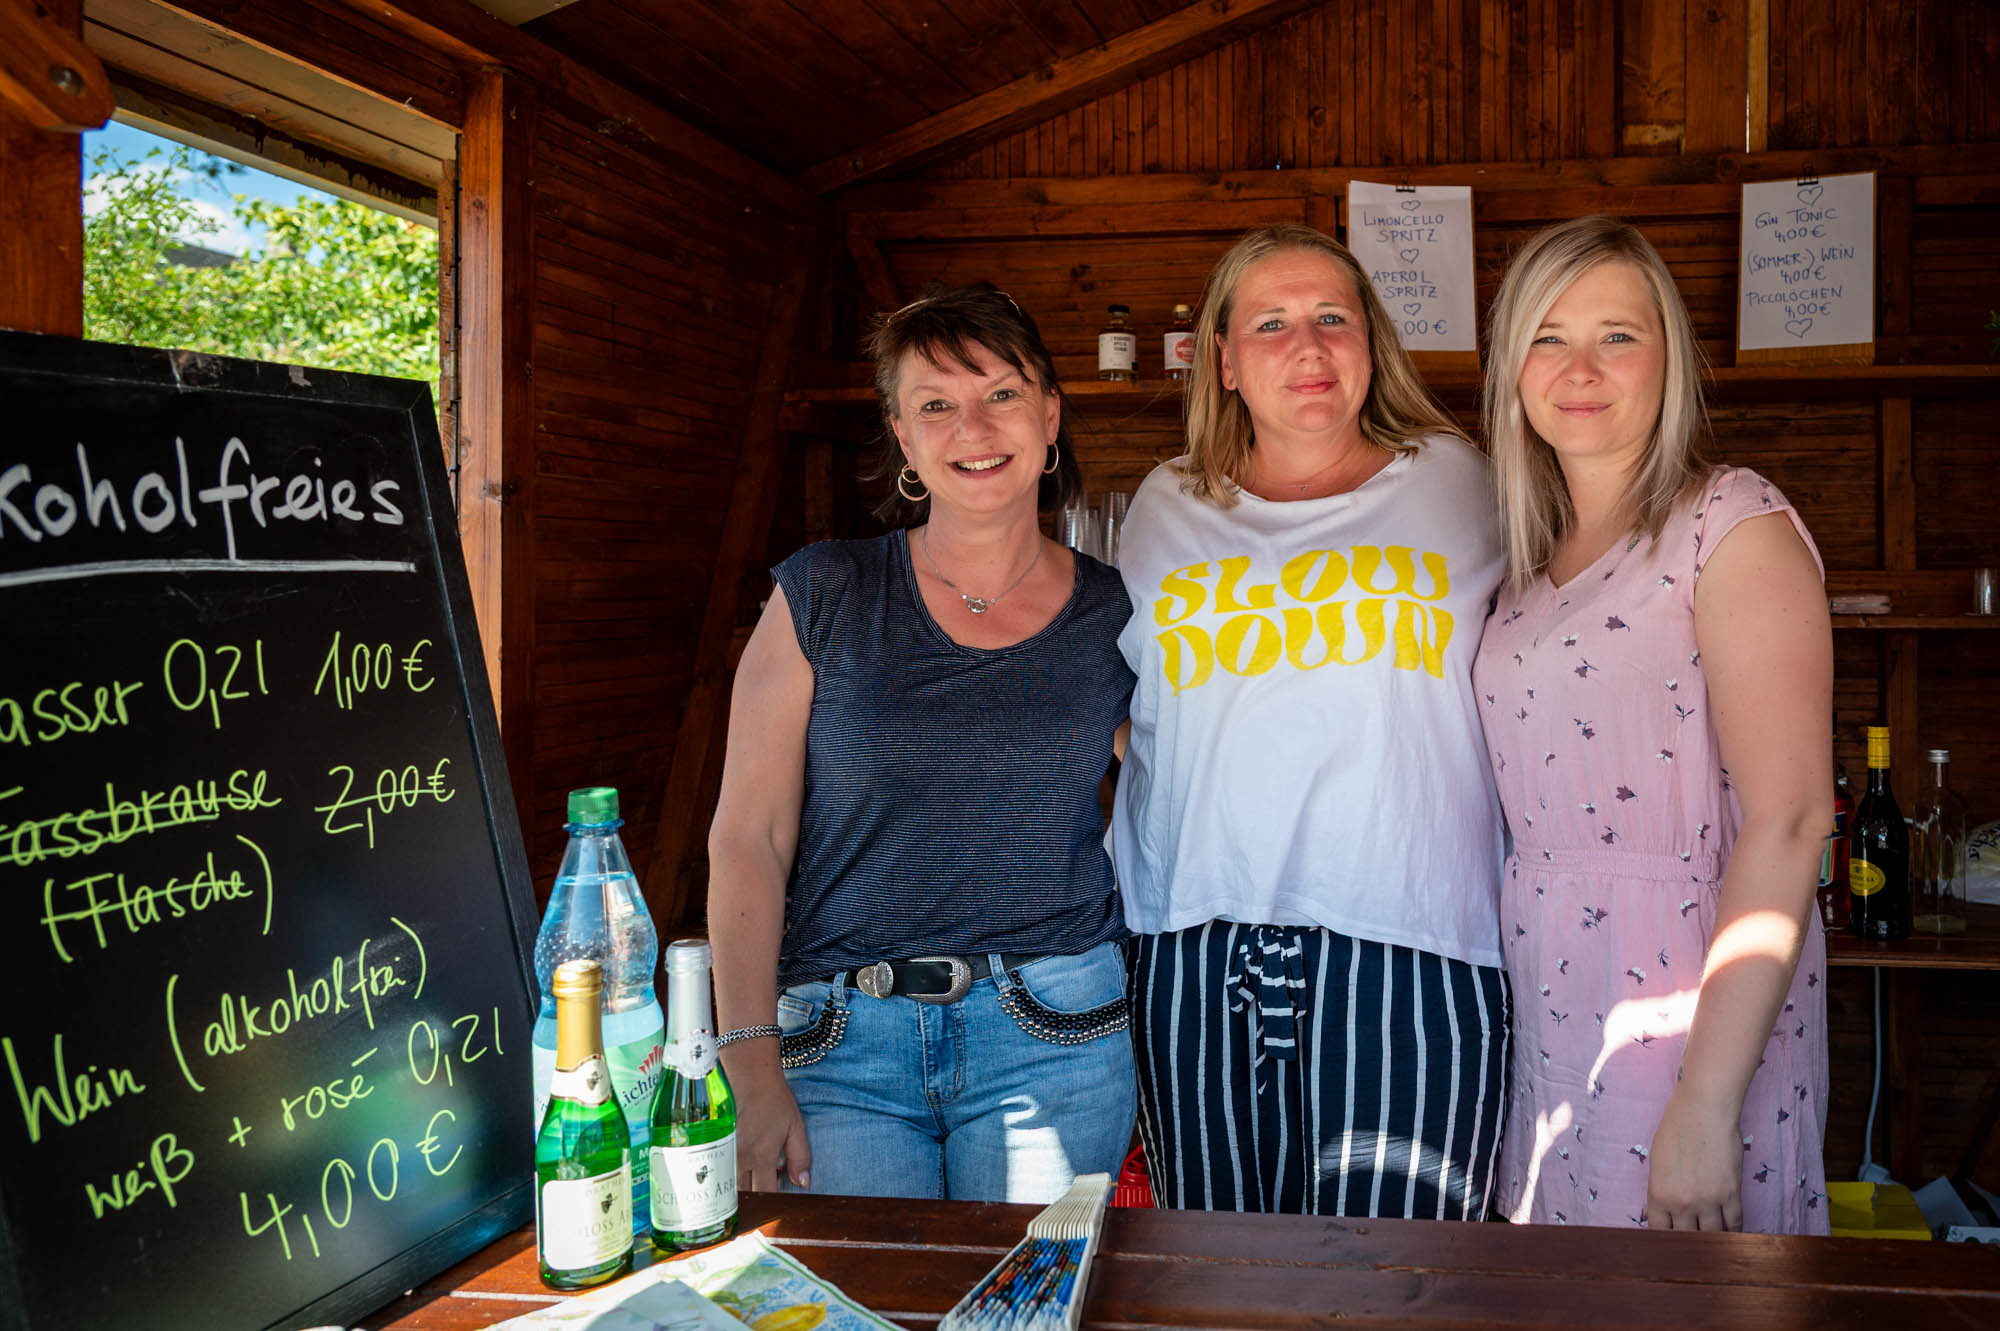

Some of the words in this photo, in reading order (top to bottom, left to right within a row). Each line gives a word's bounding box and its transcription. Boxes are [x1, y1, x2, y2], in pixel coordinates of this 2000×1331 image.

[1786, 208, 1839, 224] TONIC
[1376, 228, 1438, 243] SPRITZ
[1821, 244, 1855, 262] WEIN
[1372, 270, 1432, 284] APEROL
[1383, 284, 1438, 299] SPRITZ
[1153, 545, 1450, 627] SLOW
[1154, 598, 1455, 697] DOWN
[2, 1035, 145, 1143] Wein
